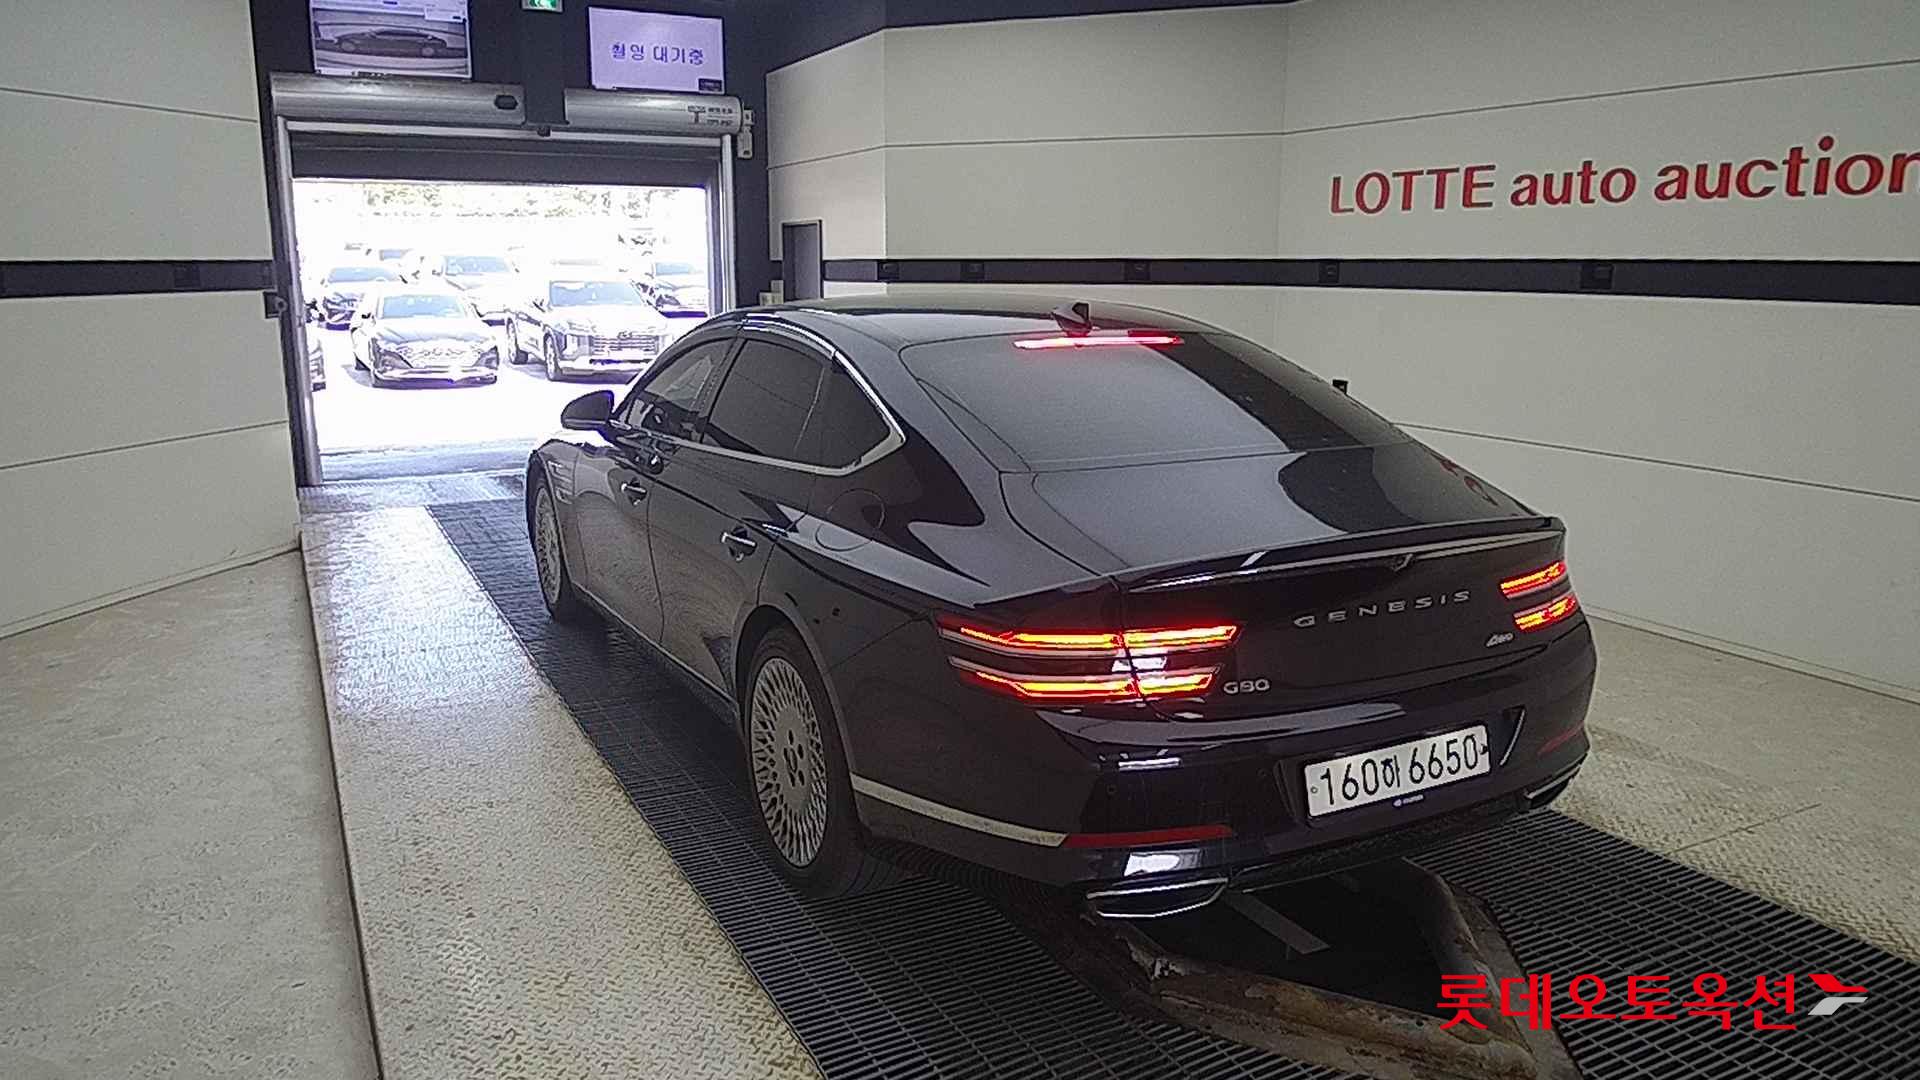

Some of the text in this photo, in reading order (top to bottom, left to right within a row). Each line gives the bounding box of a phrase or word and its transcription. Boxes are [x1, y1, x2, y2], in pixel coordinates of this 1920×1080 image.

[653, 46, 703, 66] 대기중
[1331, 135, 1920, 214] LOTTE auto auction
[1294, 591, 1471, 627] GENESIS
[1409, 734, 1478, 785] 6650
